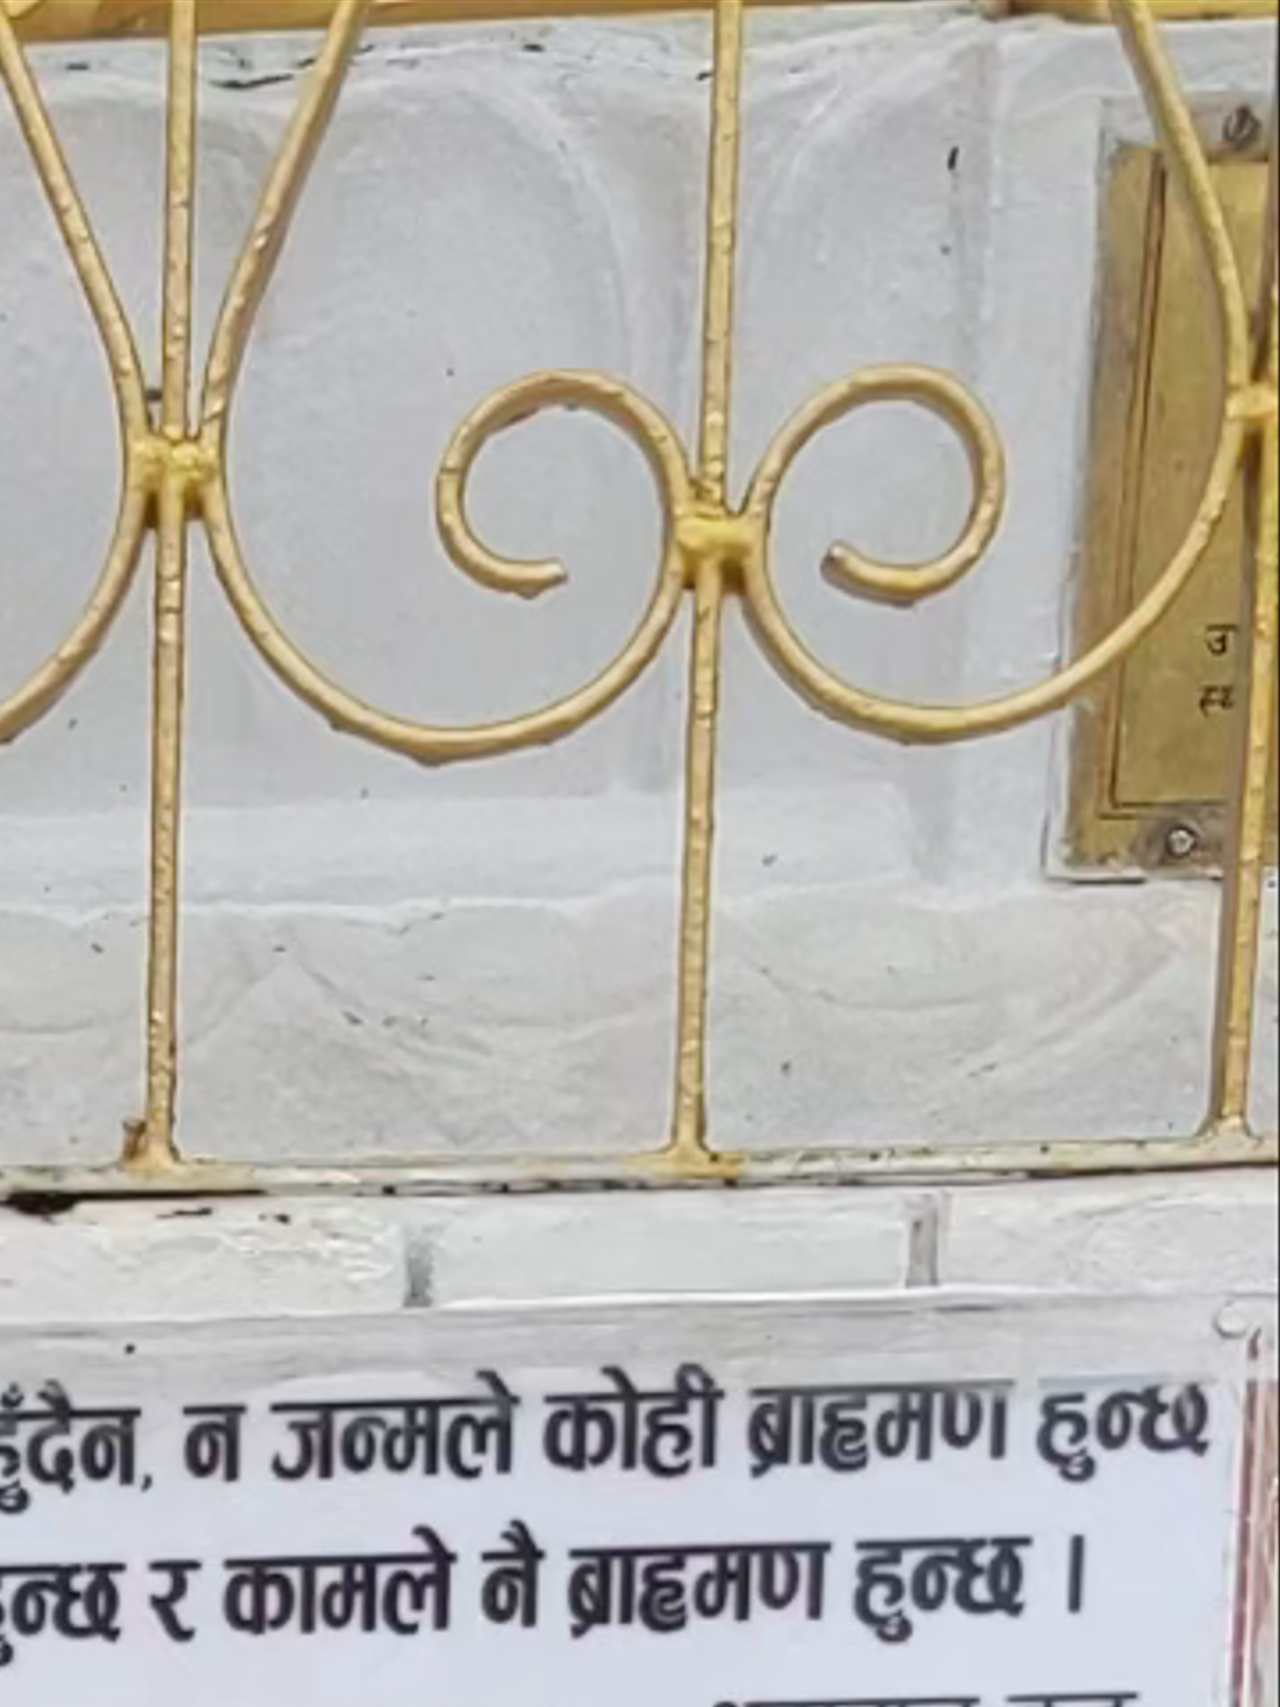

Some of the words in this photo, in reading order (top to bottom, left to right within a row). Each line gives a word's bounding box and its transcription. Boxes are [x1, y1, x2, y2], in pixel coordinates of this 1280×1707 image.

[183, 1405, 246, 1483] न
[270, 1370, 520, 1480] जन्मले
[544, 1363, 725, 1477] कोही
[1036, 1376, 1217, 1482] हुन्छ
[148, 1560, 201, 1642] र
[224, 1525, 456, 1634] कामले
[481, 1519, 545, 1628] नै
[853, 1536, 1032, 1643] हुन्छ
